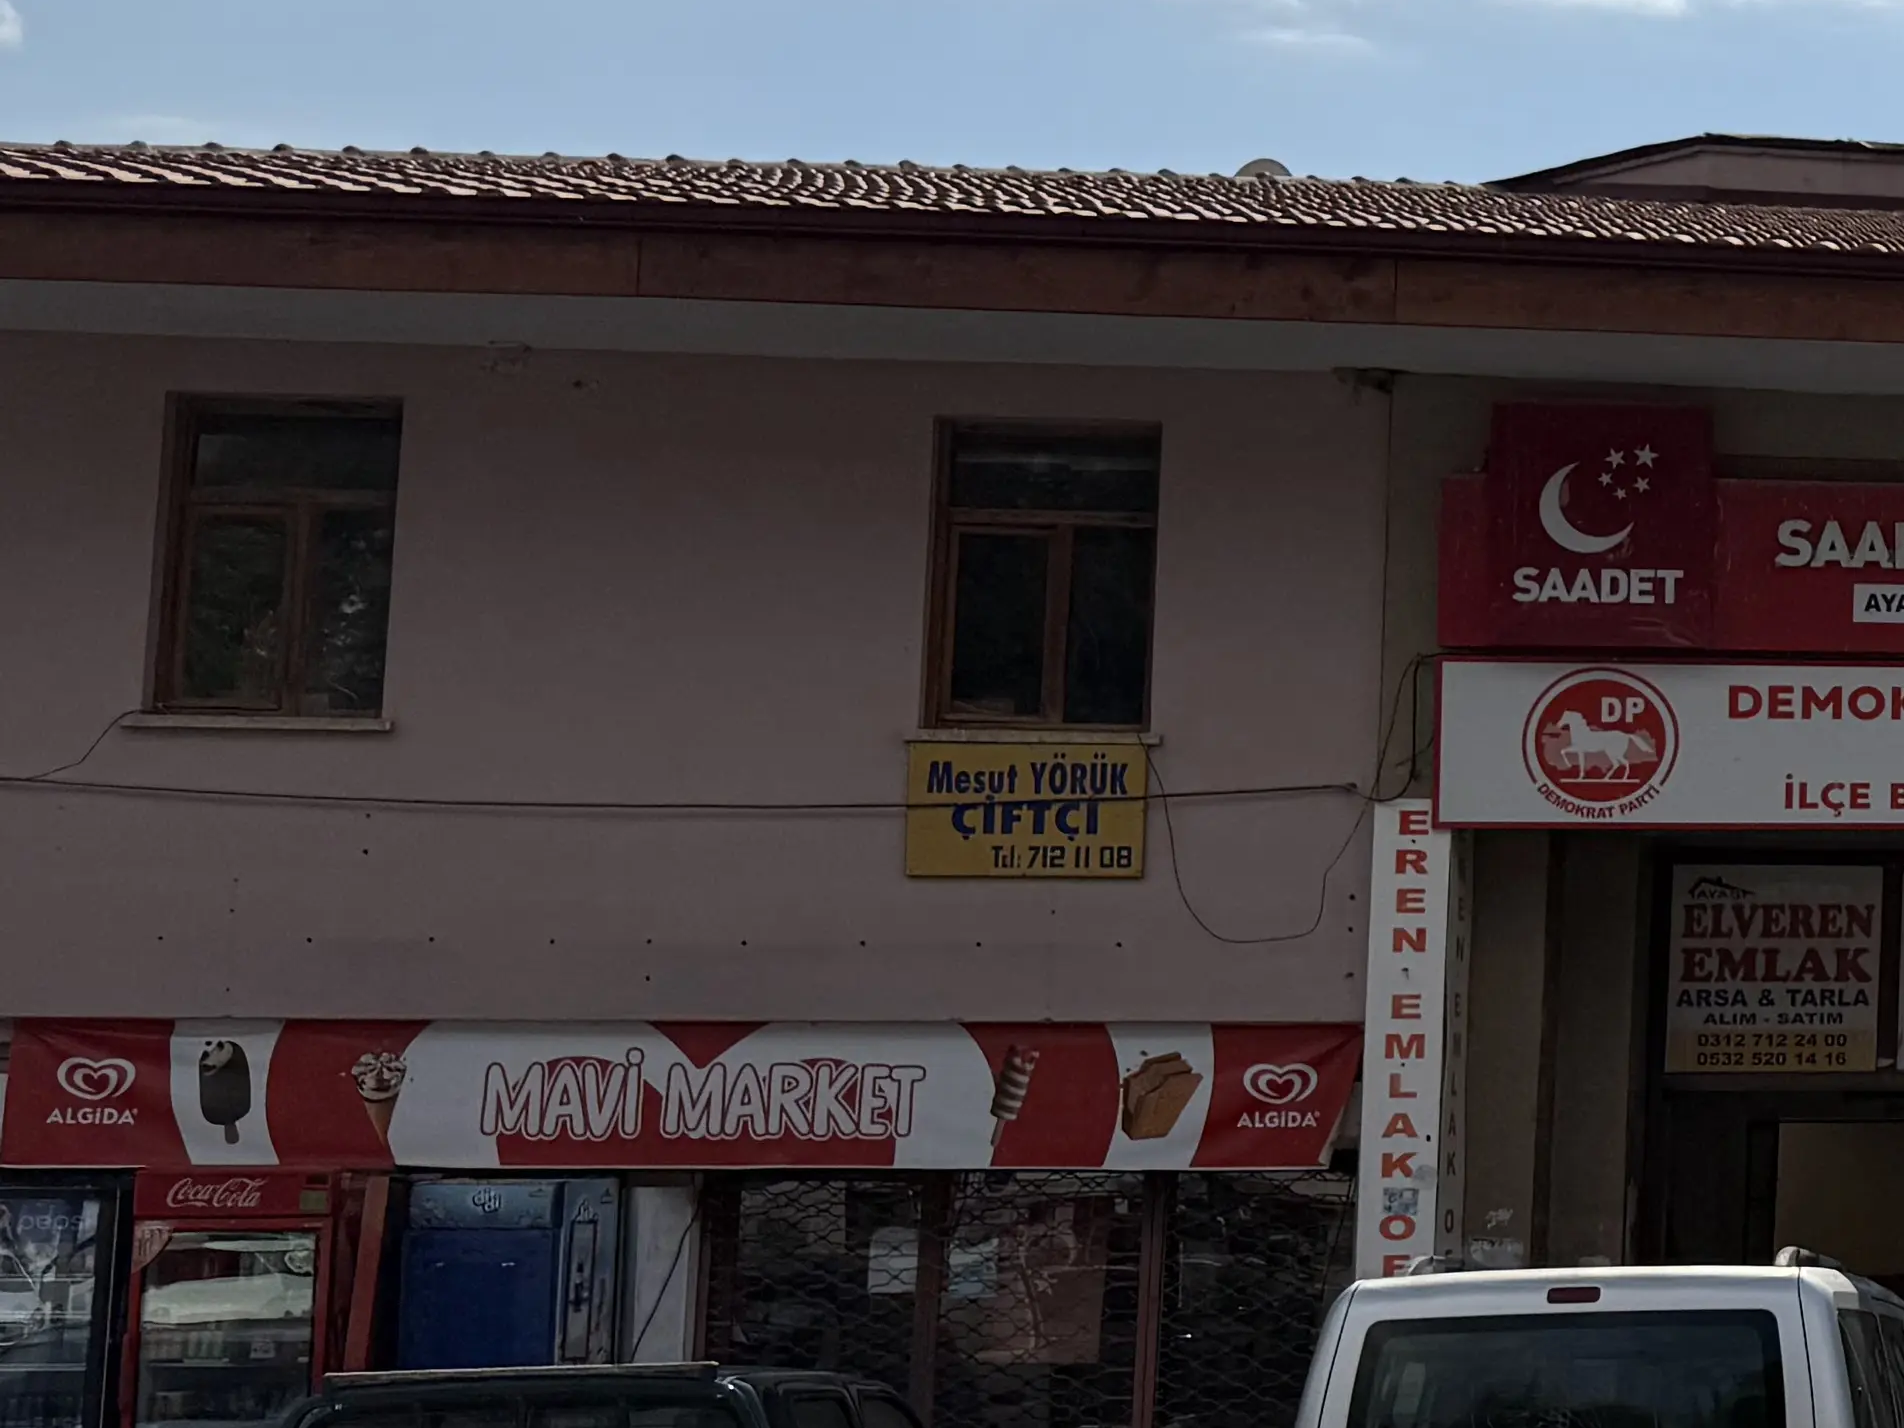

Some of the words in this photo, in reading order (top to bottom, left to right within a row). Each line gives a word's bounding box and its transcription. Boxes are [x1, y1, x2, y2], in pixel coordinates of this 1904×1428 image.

[1513, 568, 1685, 605] SAADET
[1601, 696, 1646, 723] DP
[927, 760, 1018, 794] Mesut
[1030, 752, 1129, 795] YÖRÜK
[1537, 782, 1616, 820] DEMOKRAT
[1784, 773, 1871, 817] İLÇE
[1027, 846, 1066, 869] 712
[1074, 846, 1091, 869] 11
[1099, 846, 1132, 869] 08
[1393, 810, 1430, 953] EREN
[1681, 903, 1876, 939] ELVEREN
[1679, 947, 1874, 983] EMLAK
[1676, 988, 1748, 1007] ARSA
[1758, 988, 1776, 1007] &
[1786, 988, 1870, 1007] TARLA
[1703, 1012, 1757, 1025] ALIM
[1777, 1012, 1844, 1025] SATIM
[1697, 1033, 1746, 1048] 0312
[1752, 1033, 1788, 1048] 712
[1794, 1033, 1817, 1048] 24
[1824, 1033, 1848, 1048] 00
[1696, 1052, 1745, 1067] 0532
[1752, 1052, 1787, 1067] 520
[1795, 1053, 1817, 1067] 14
[1824, 1053, 1847, 1067] 16
[480, 1047, 645, 1140] MAVİ
[660, 1062, 927, 1141] MARKET
[1381, 993, 1427, 1179] EMLAK
[166, 1176, 269, 1208] Coca-Cola
